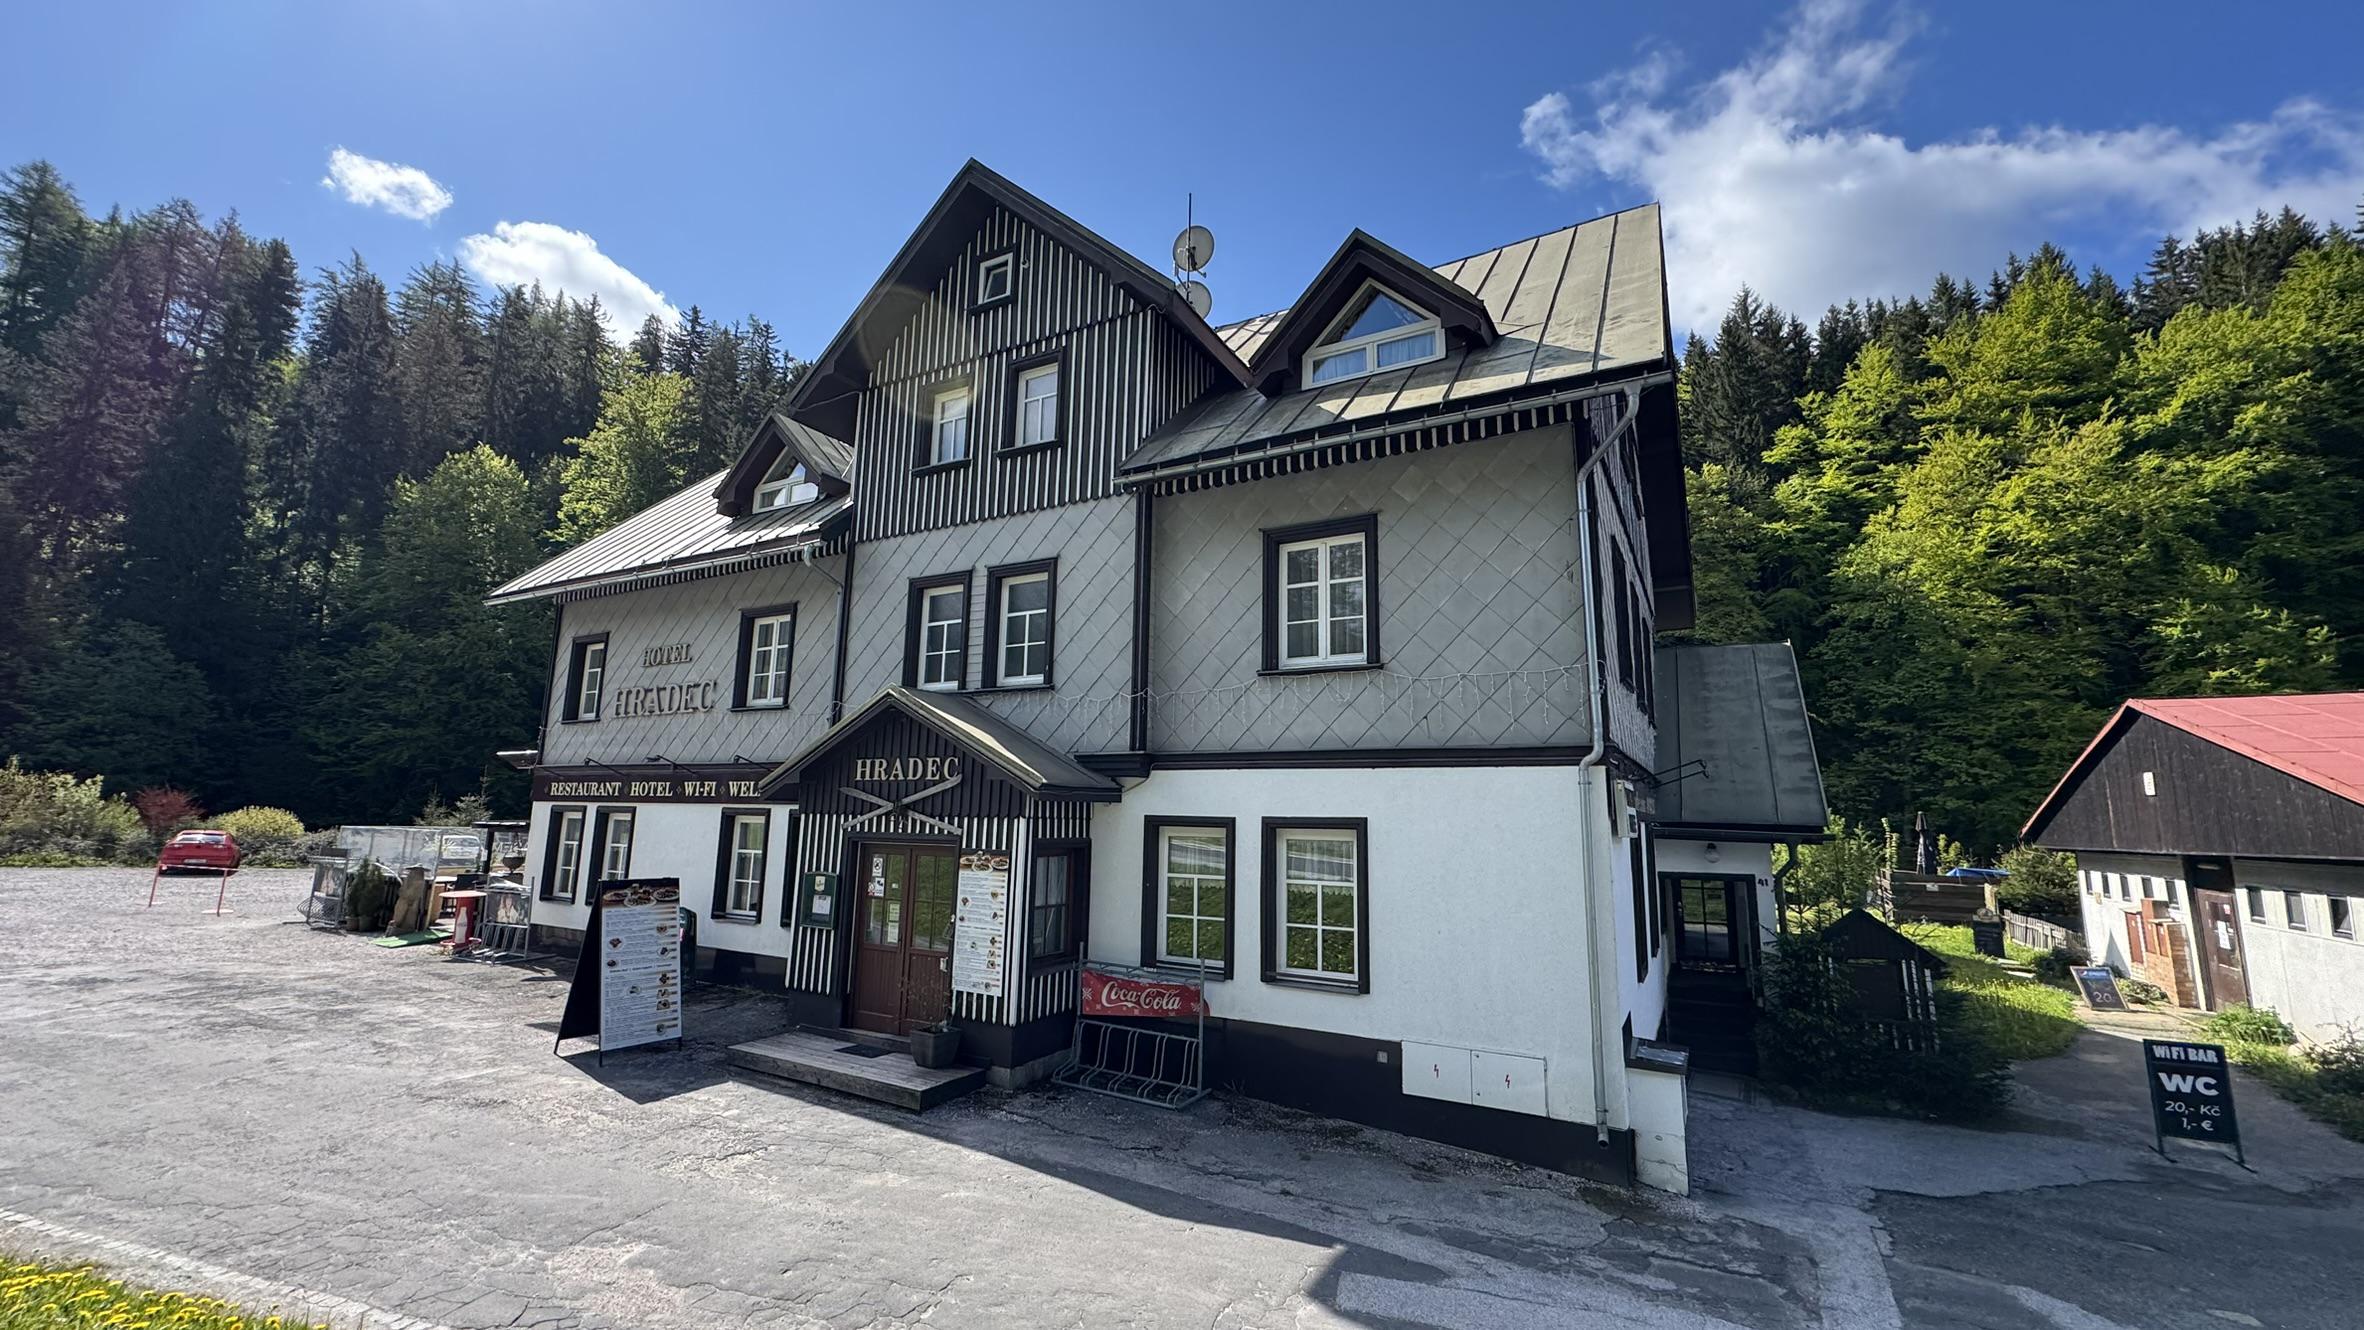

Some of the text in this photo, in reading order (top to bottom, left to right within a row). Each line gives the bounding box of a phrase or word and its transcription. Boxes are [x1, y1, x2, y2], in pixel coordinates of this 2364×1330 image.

[641, 644, 692, 667] HOTEL
[611, 680, 717, 719] HRADEC
[855, 756, 960, 781] HRADEC
[550, 781, 760, 797] RESTAURANT HOTEL WI-FI WEL
[1101, 981, 1182, 1010] Coca-Cola
[2187, 1048, 2218, 1063] BAR
[2158, 1072, 2220, 1097] WC
[2165, 1100, 2221, 1117] 20,- Kč
[2201, 1120, 2215, 1131] €
